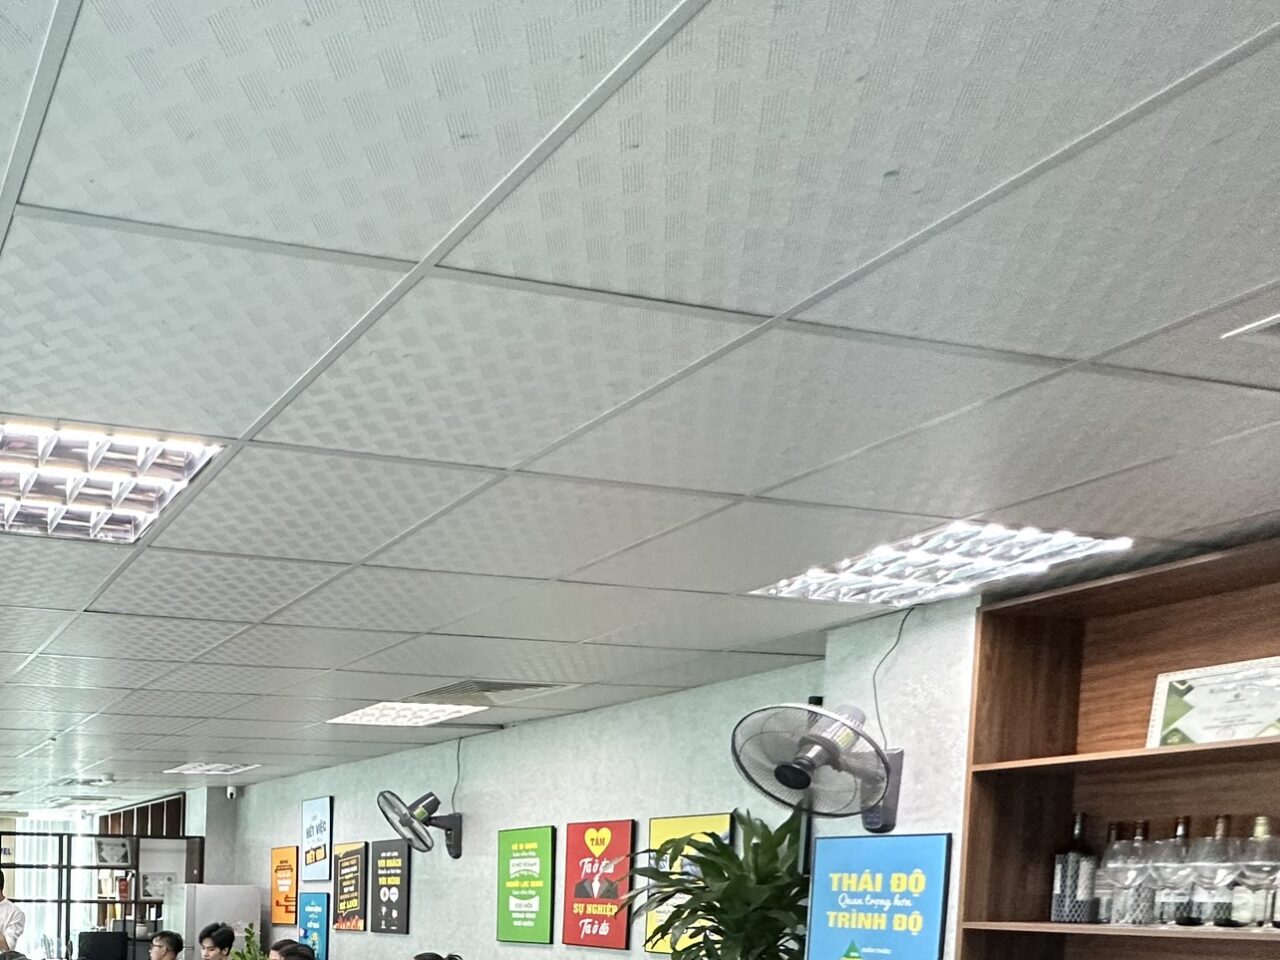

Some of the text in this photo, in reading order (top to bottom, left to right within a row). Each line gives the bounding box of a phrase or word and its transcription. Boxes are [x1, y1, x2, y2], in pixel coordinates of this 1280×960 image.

[829, 868, 926, 897] THÁI ĐỘ
[573, 902, 618, 917] SỰ NGHIỆP
[838, 893, 864, 909] Quan
[865, 894, 892, 911] trọng
[827, 909, 923, 935] TRÌNH ĐỘ
